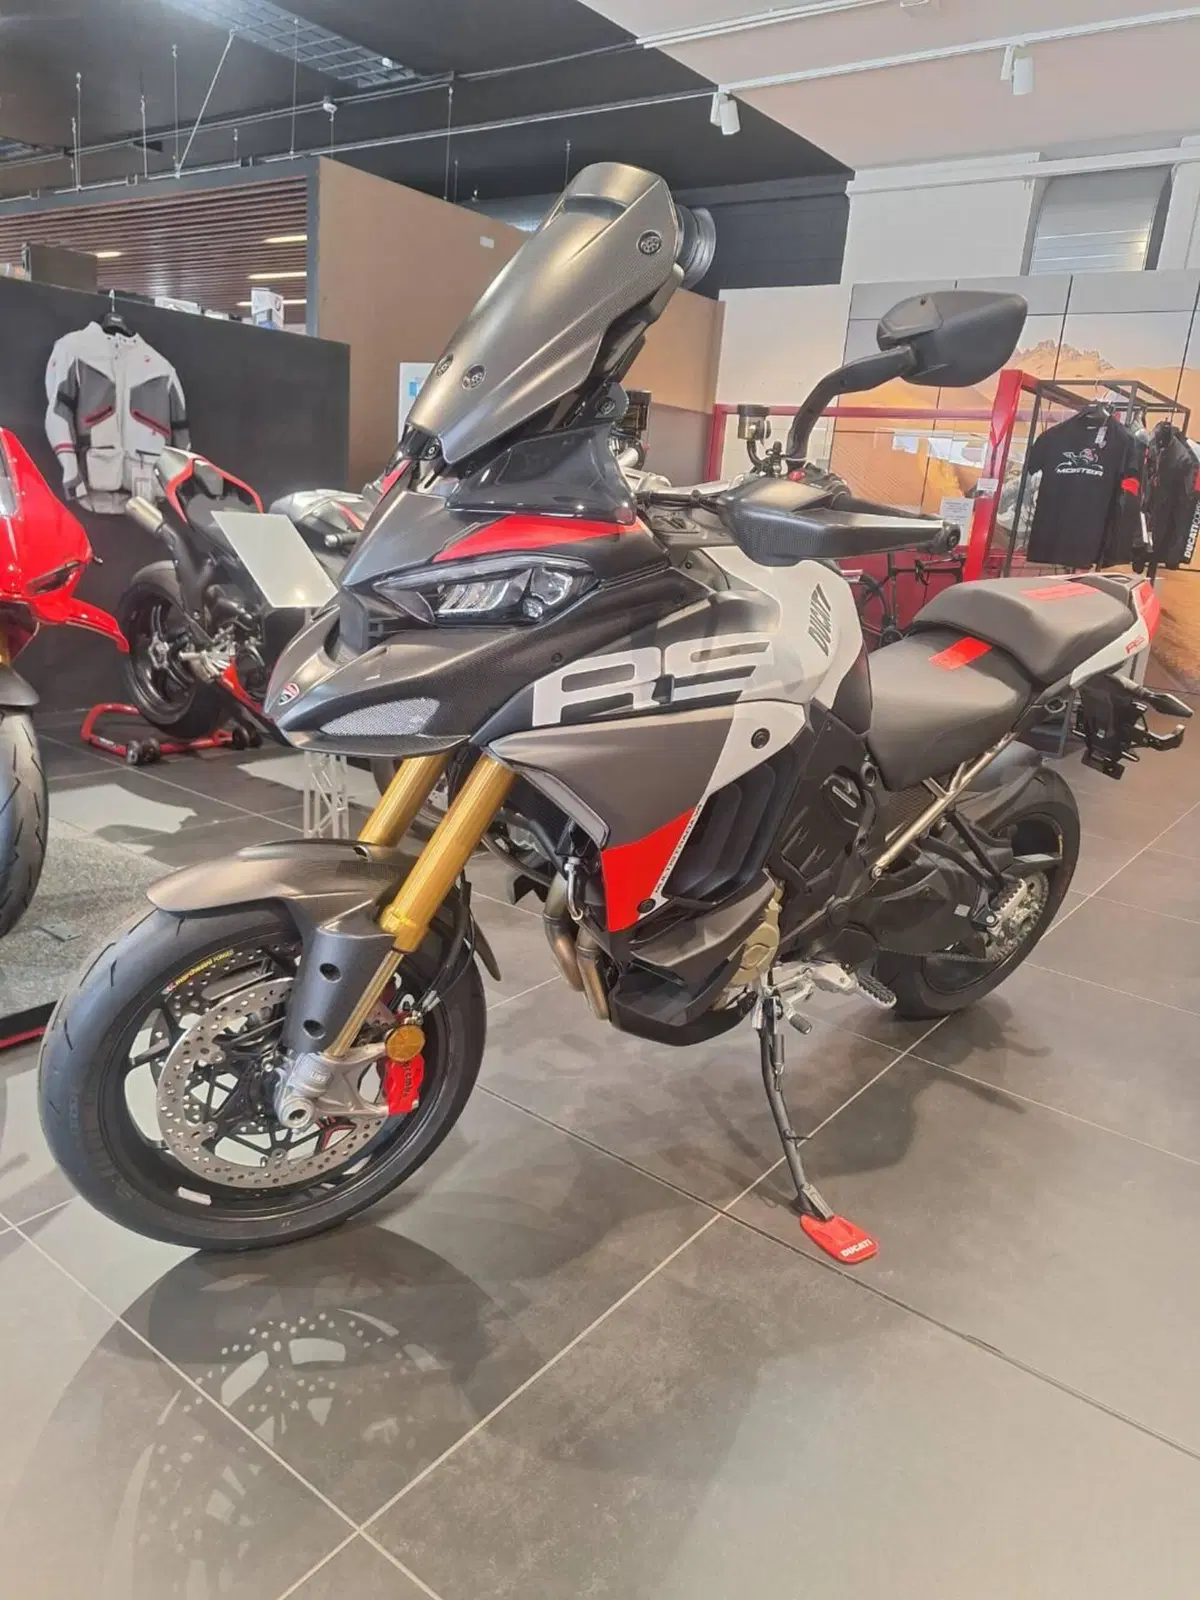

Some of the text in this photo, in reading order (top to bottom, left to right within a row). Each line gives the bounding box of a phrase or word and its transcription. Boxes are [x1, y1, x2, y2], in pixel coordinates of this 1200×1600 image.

[808, 583, 832, 657] DUCATI
[532, 632, 776, 727] RS
[840, 1238, 873, 1257] DUCATI
